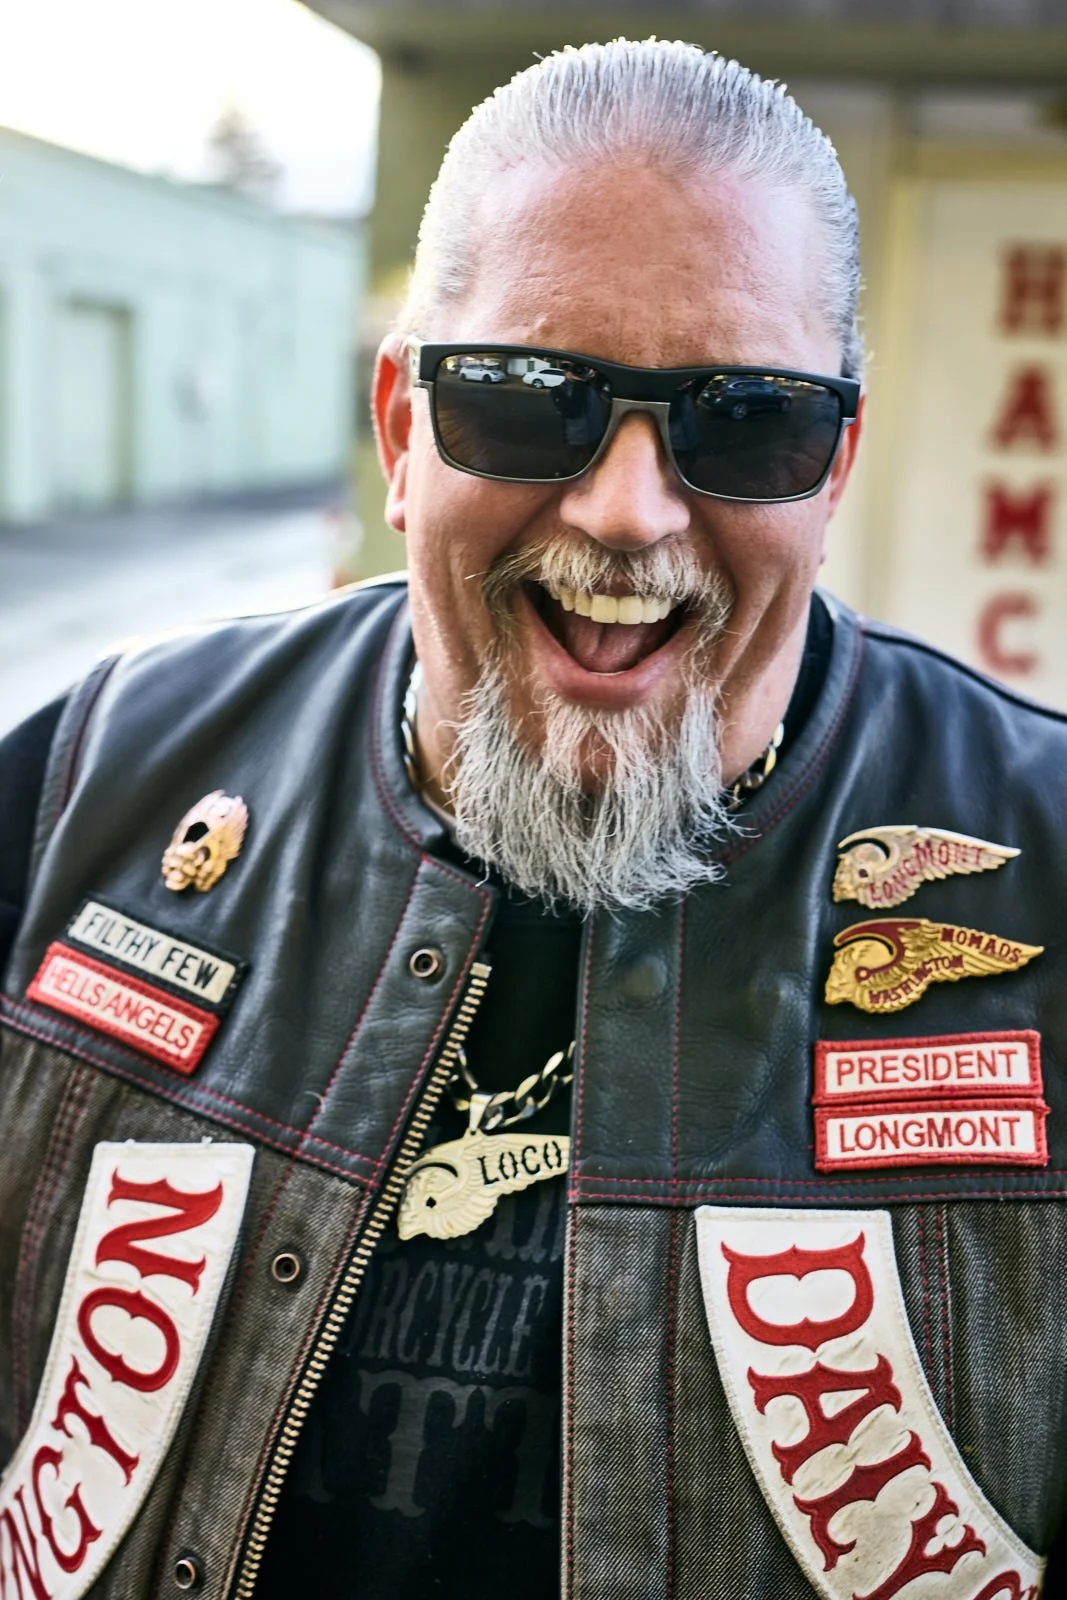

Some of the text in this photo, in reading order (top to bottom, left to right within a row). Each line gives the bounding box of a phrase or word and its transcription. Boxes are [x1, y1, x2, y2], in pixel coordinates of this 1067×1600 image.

[974, 240, 1067, 678] HAMC
[868, 840, 986, 902] LONGMONT
[82, 911, 219, 990] FILTHY FEW
[940, 928, 1022, 963] NOMADS
[48, 961, 195, 1051] HELLS ANGELS
[868, 955, 965, 1005] WASHINGTON
[836, 1048, 1018, 1086] PRESIDENT
[476, 1139, 563, 1185] LOCO
[839, 1116, 1021, 1153] LONGMONT
[0, 1165, 224, 1600] NGTON
[720, 1230, 987, 1600] DALY
